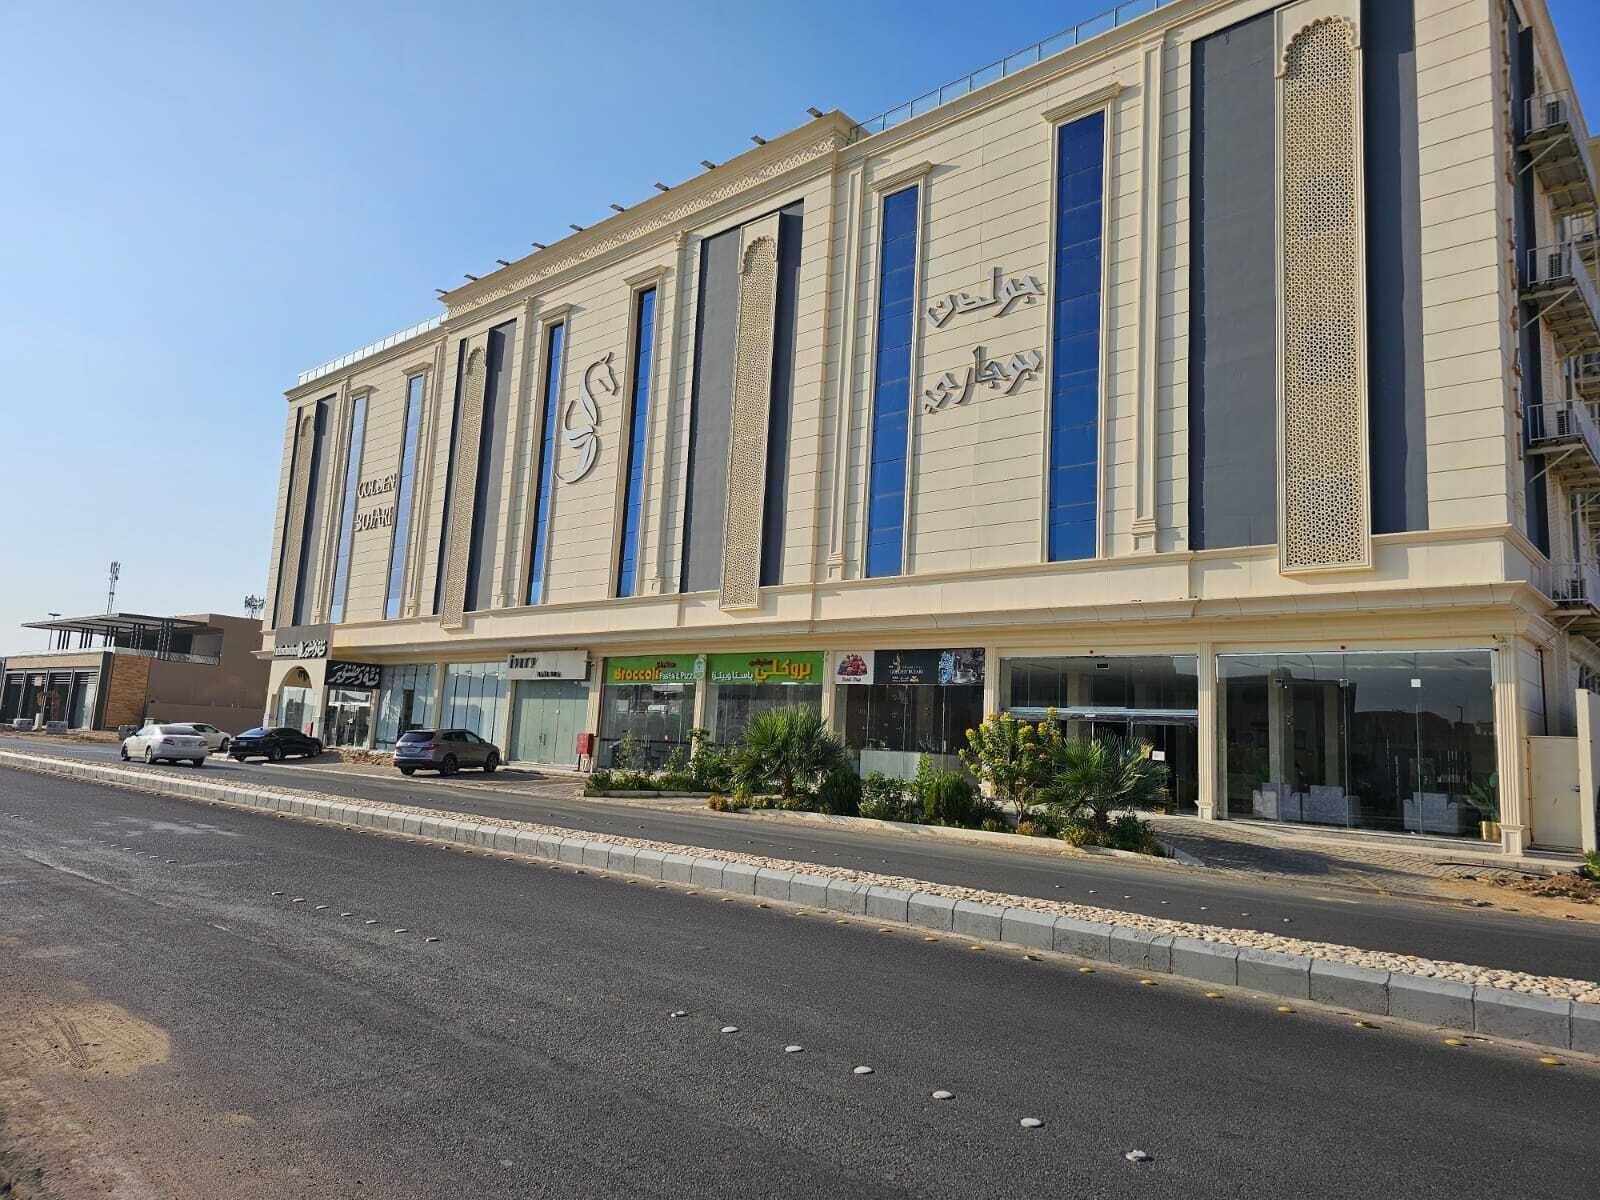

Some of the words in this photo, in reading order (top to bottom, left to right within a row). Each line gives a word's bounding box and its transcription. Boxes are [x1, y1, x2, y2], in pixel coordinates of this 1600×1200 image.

[358, 473, 397, 498] GOLDEN
[614, 666, 660, 681] Broccoli
[754, 657, 813, 683] بروكلي
